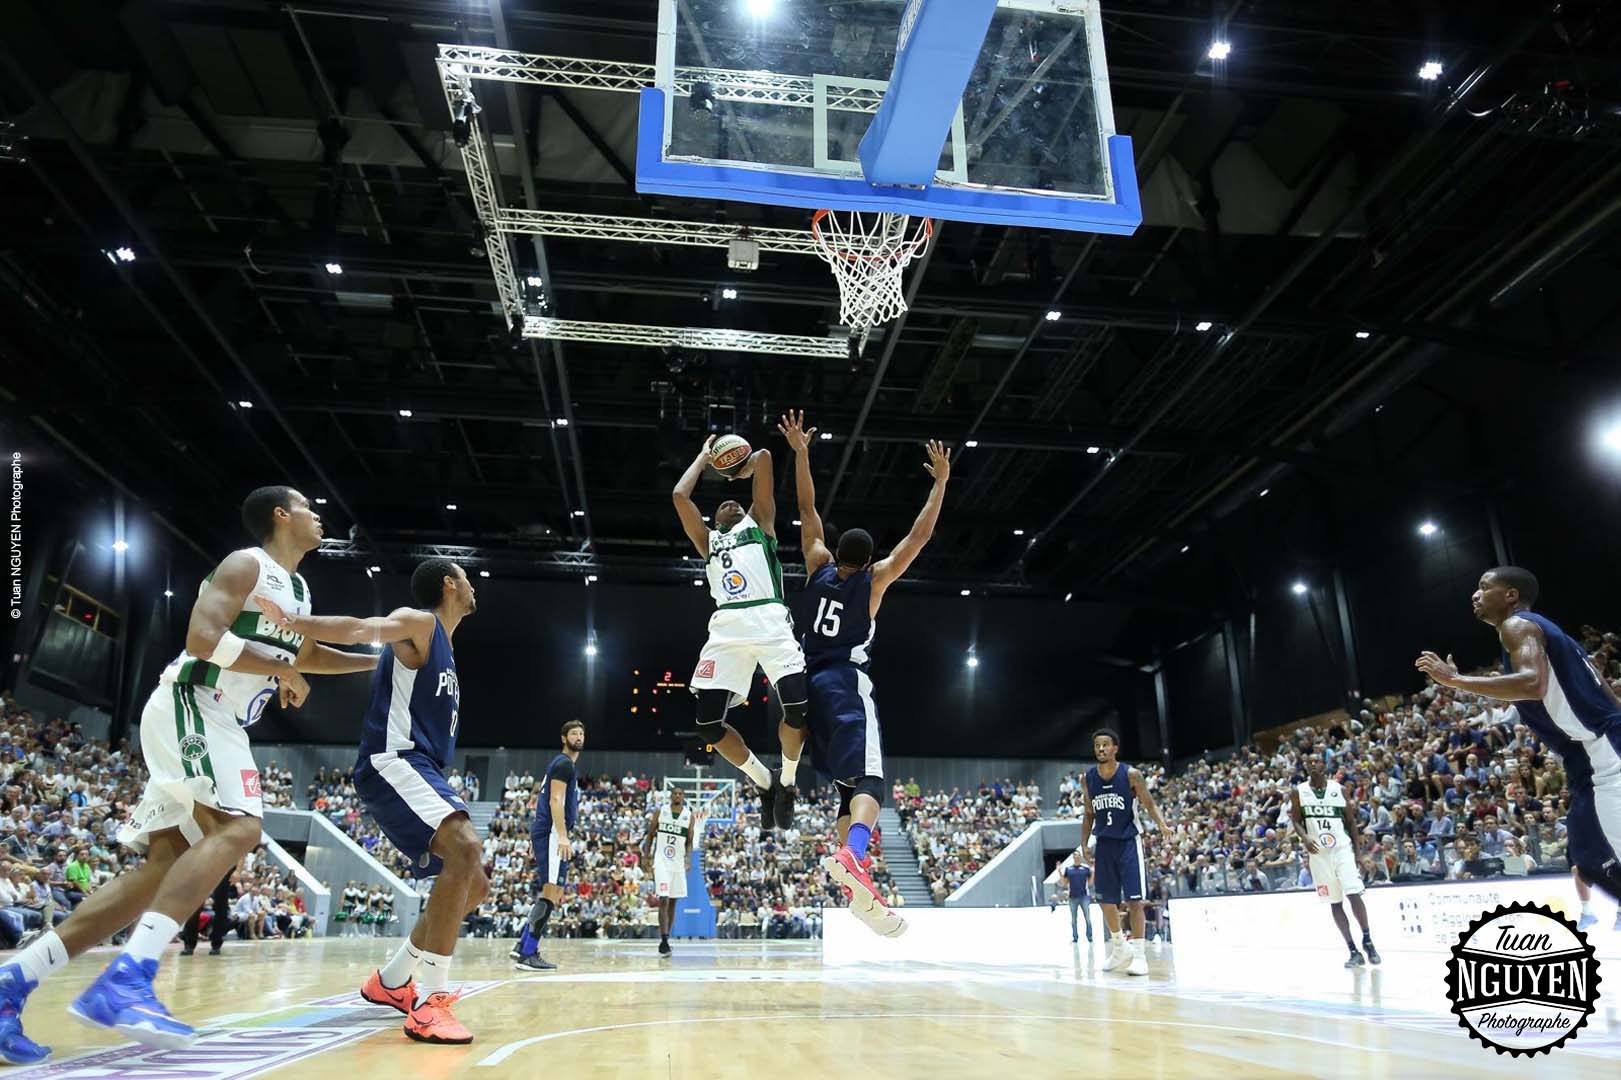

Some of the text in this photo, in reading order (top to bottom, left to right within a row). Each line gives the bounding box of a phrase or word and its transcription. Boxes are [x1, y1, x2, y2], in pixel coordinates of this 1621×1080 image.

[721, 552, 732, 569] 8
[813, 597, 844, 637] 15
[664, 671, 672, 682] 2
[1316, 819, 1331, 831] 14
[666, 835, 677, 846] 12
